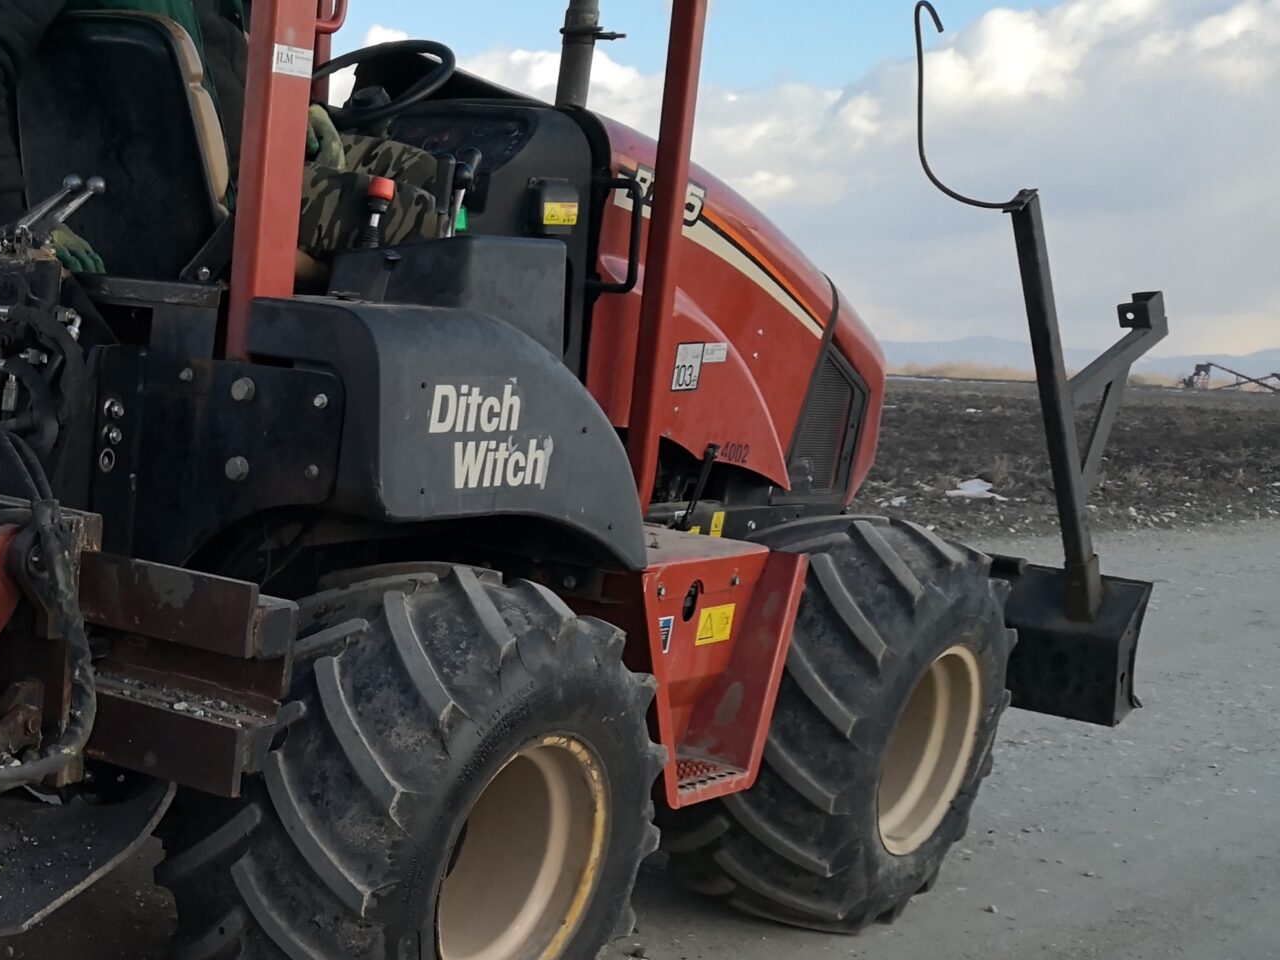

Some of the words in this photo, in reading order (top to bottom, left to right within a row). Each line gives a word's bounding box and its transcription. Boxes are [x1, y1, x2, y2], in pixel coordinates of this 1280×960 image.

[675, 364, 693, 388] 103
[429, 384, 521, 433] Ditch
[454, 438, 547, 489] Witch
